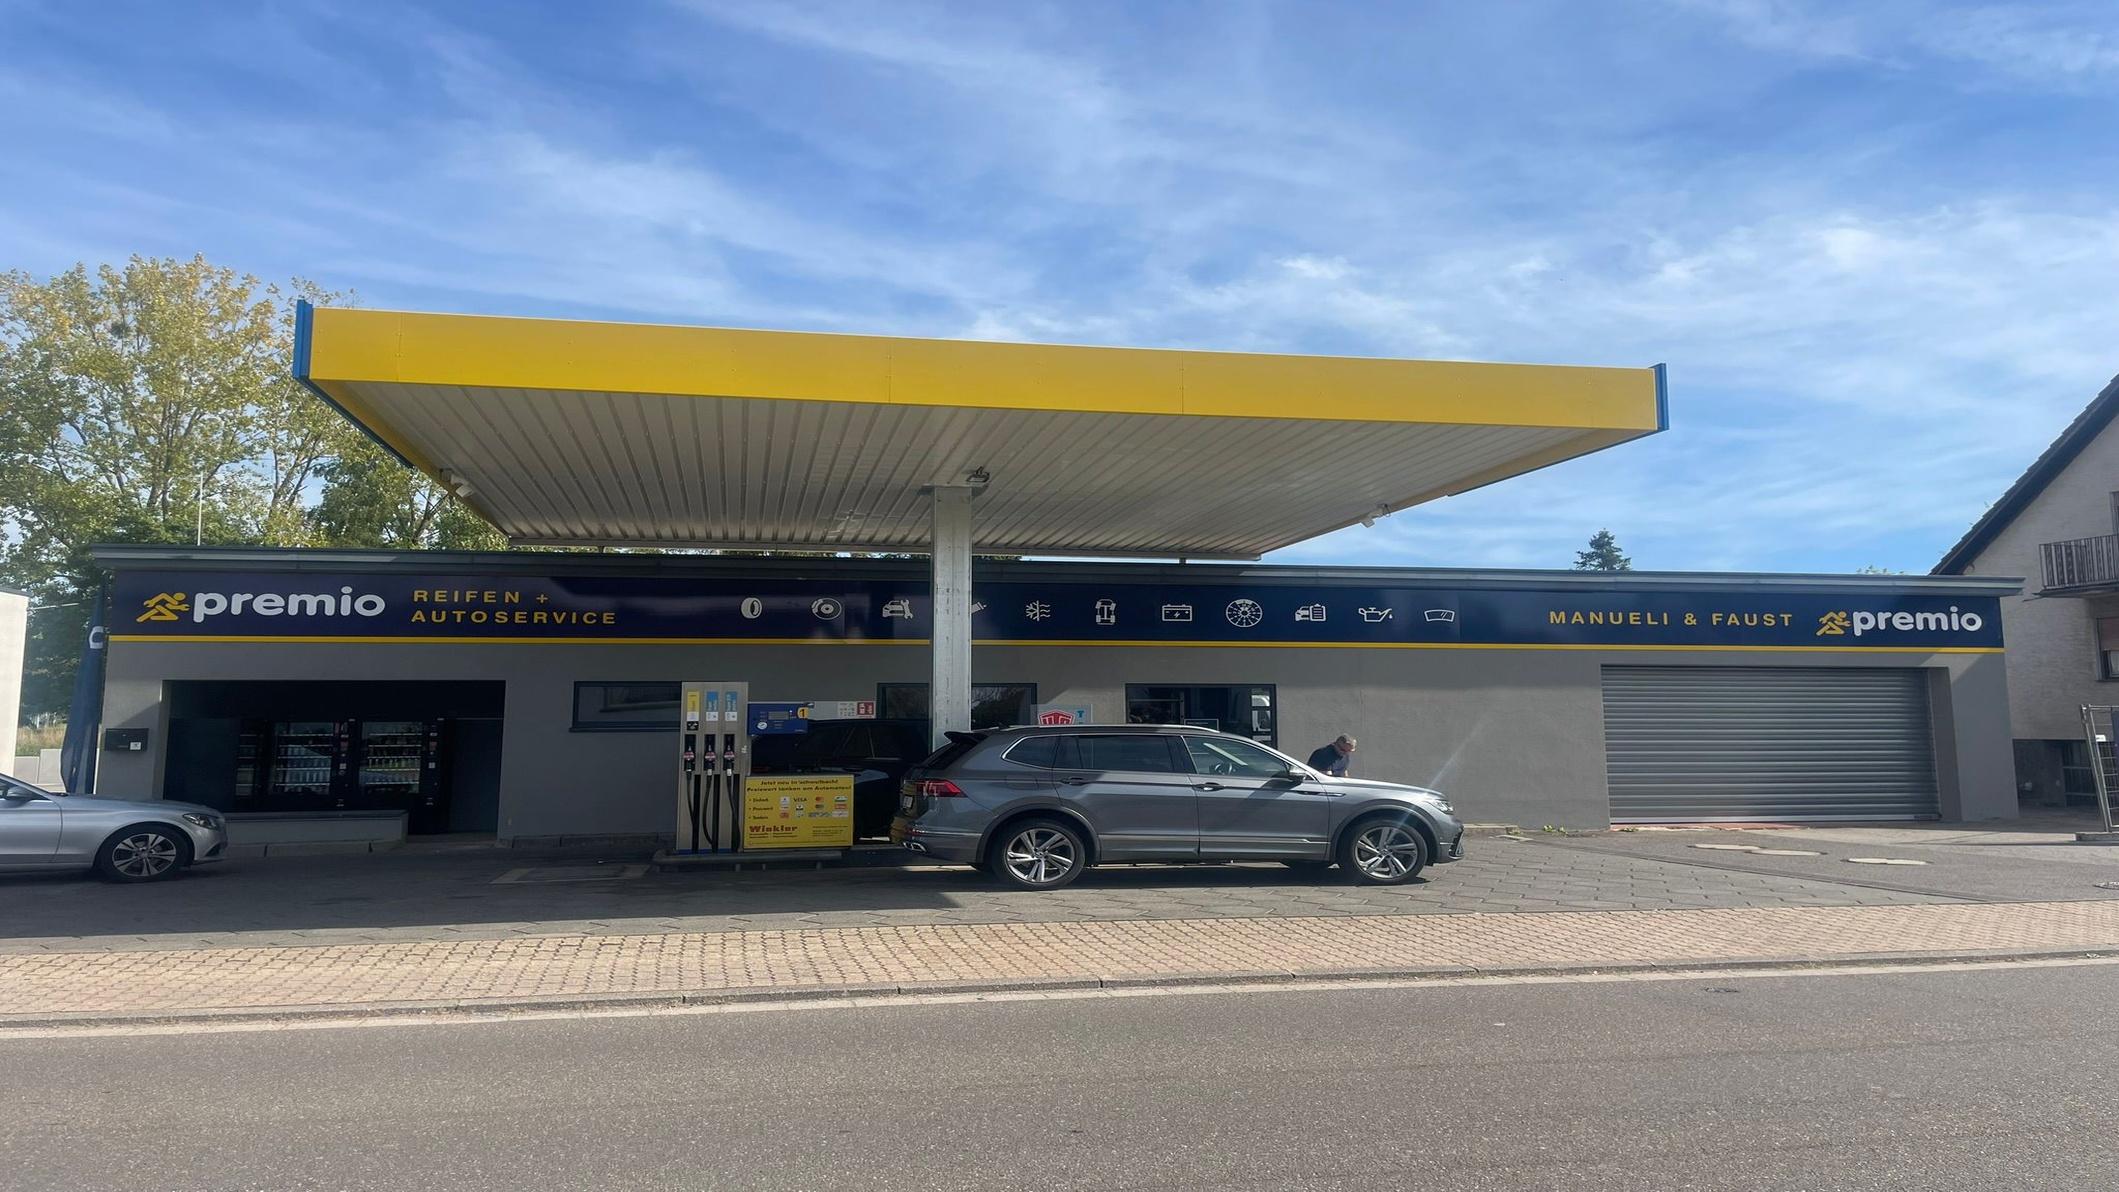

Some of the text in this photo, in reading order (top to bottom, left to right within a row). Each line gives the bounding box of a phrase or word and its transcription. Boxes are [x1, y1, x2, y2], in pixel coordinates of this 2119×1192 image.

[192, 585, 387, 624] premio
[412, 589, 549, 604] REIFEN +
[411, 609, 616, 625] AUTOSERVICE
[1549, 610, 1793, 628] MANUELI & FAUST
[1851, 605, 1983, 637] premio
